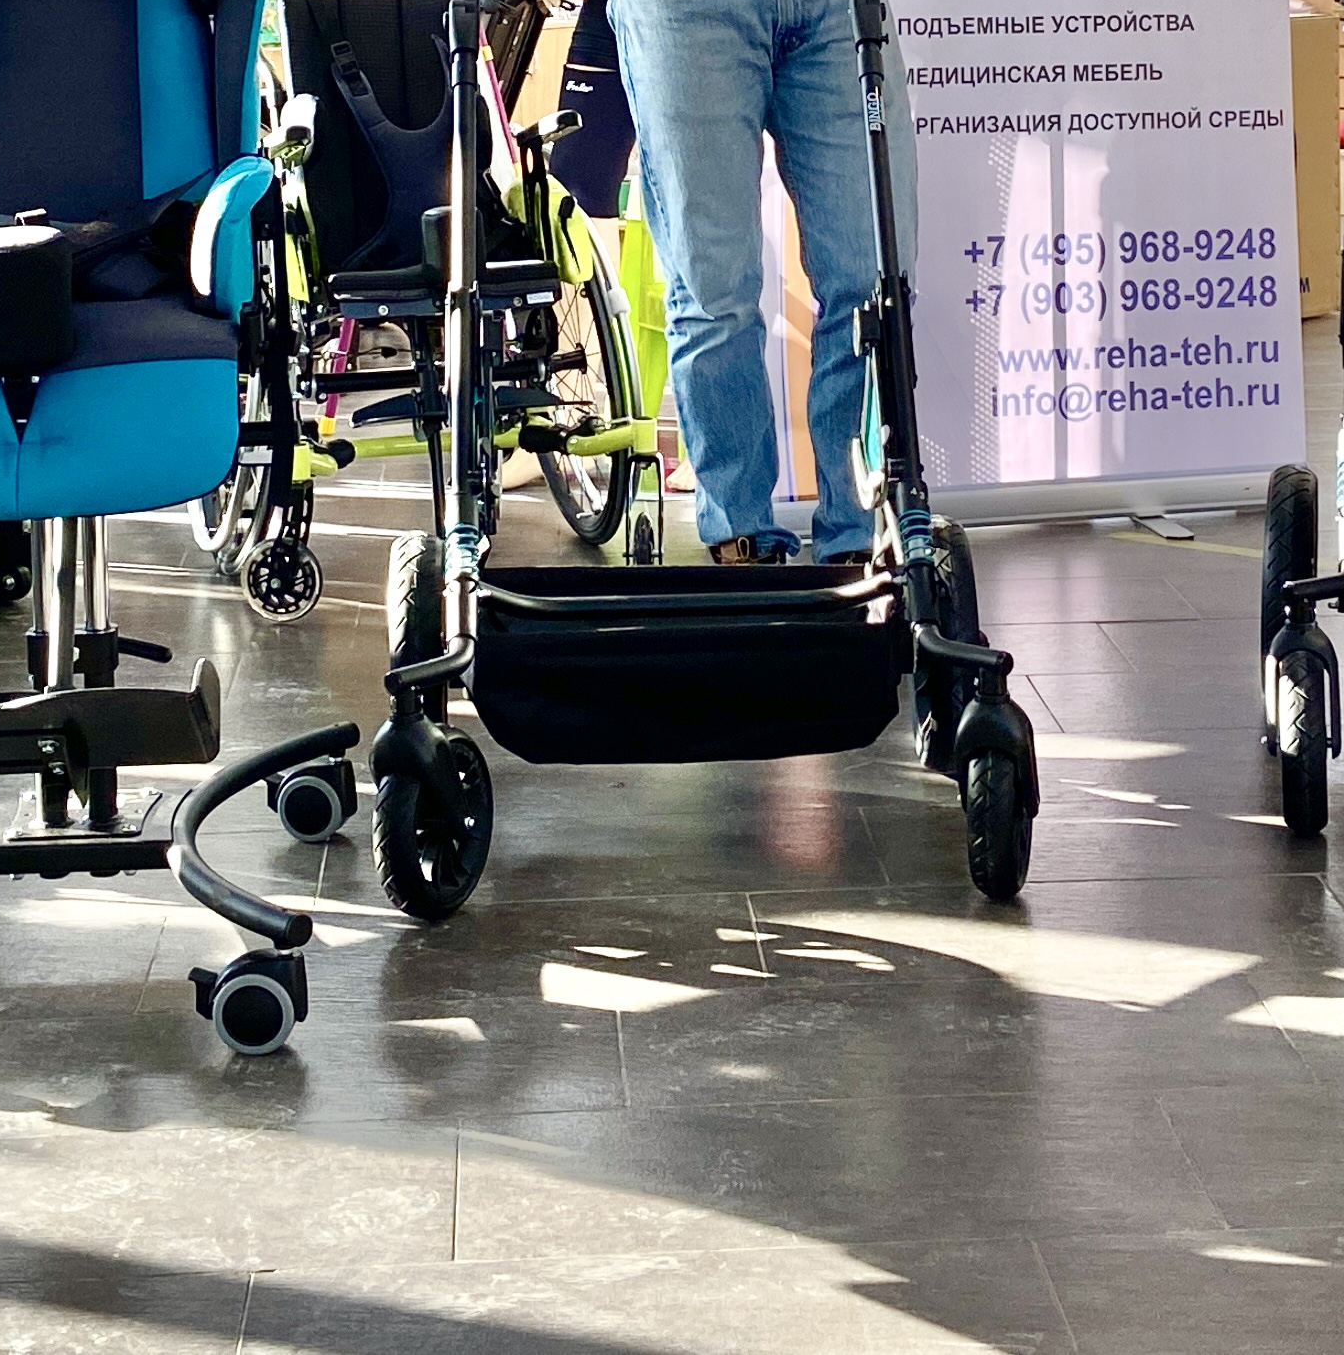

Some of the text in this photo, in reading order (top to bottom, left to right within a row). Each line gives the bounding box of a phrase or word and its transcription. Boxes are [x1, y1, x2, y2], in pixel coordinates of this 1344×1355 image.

[898, 10, 1195, 40] ПОДЪЕМНЫЕ УСТРОЙСТВА
[1073, 63, 1163, 83] МЕБЕЛЬ
[867, 92, 882, 132] BINGO
[914, 107, 1284, 135] РГАНИЗАЦИЯ ДОСТУПНОЙ СРЕДЫ
[964, 228, 1277, 274] +7 (495) 968-9248
[966, 276, 1278, 323] +7 (903) 968-9248
[999, 335, 1280, 372] www.reha-teh.ru
[992, 378, 1280, 422] info@reha-teh.ru
